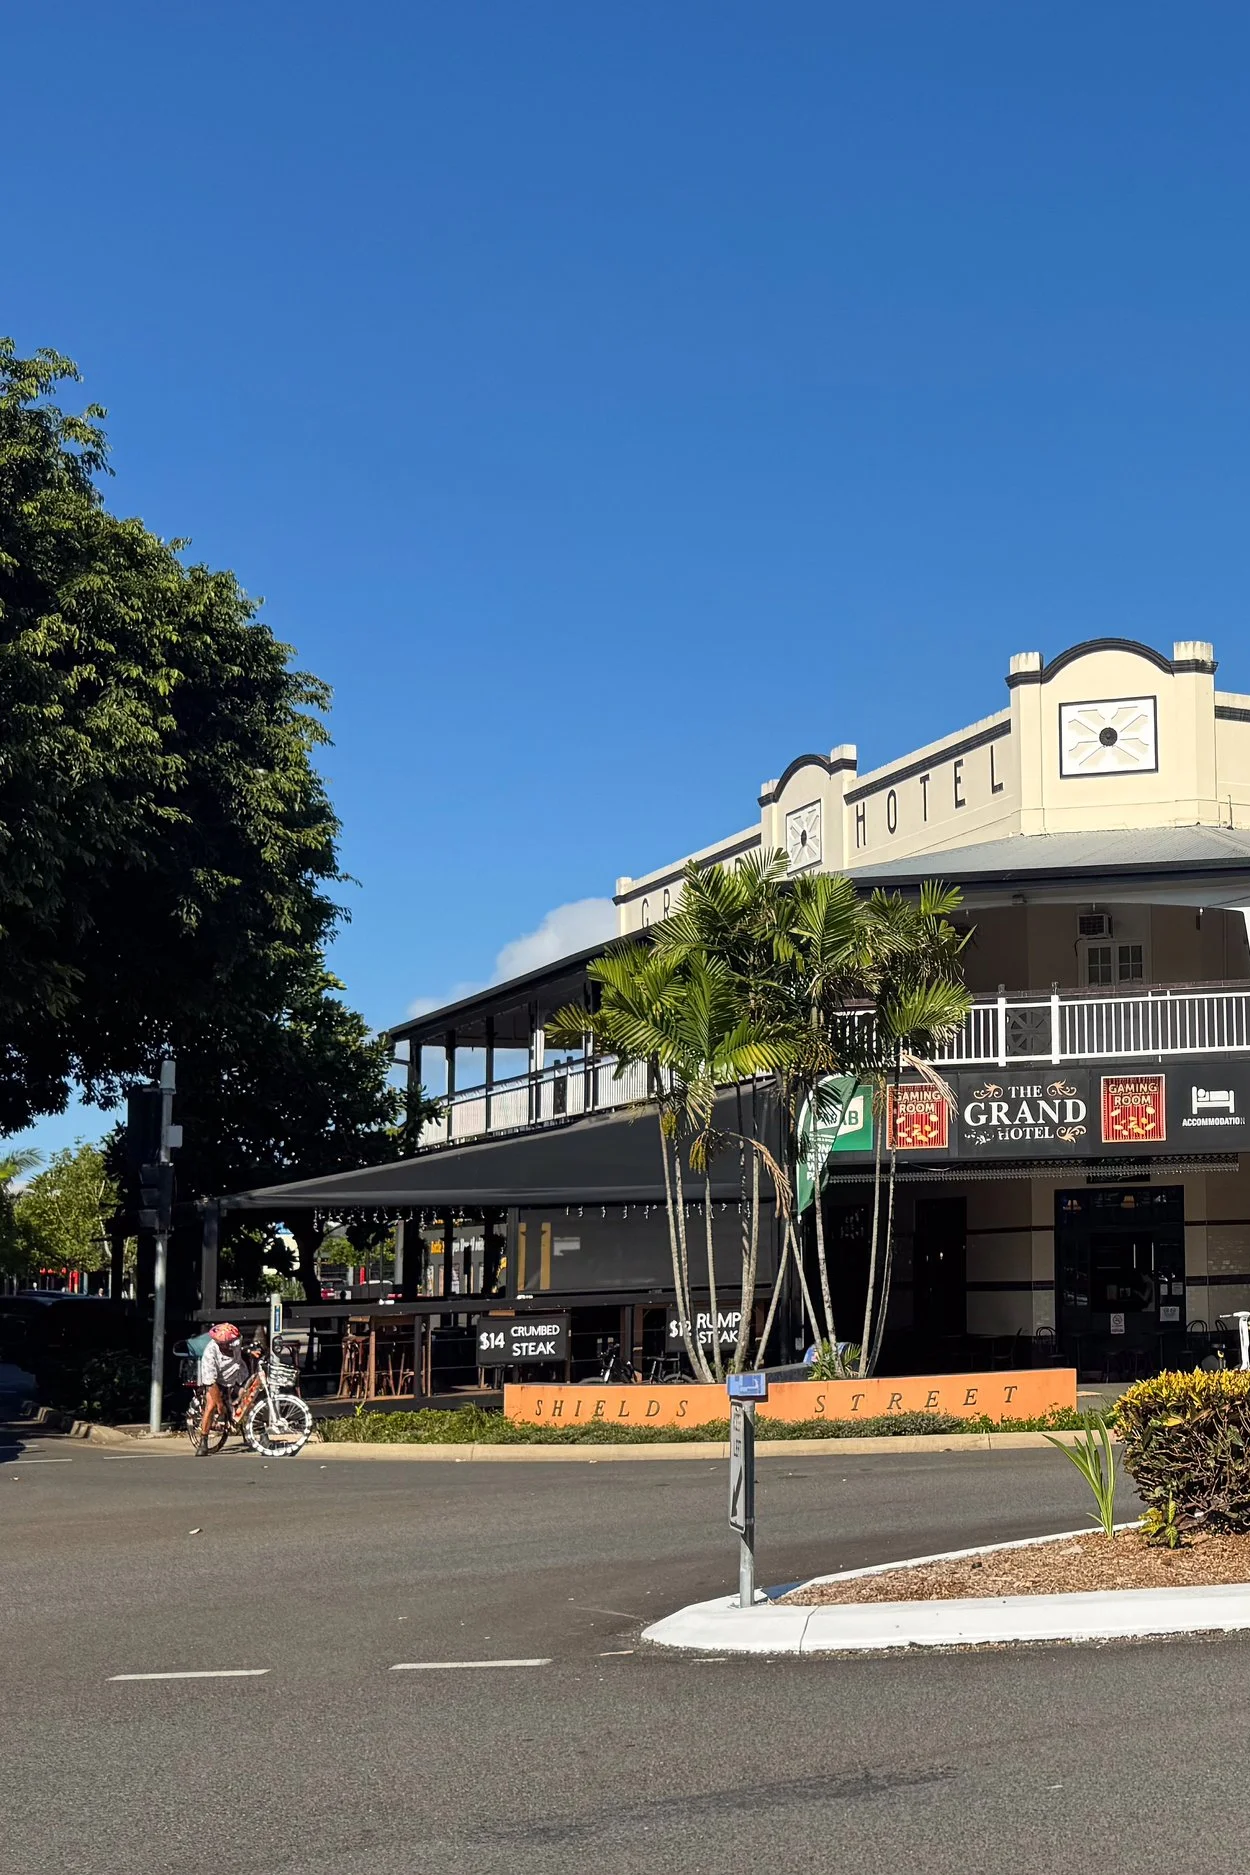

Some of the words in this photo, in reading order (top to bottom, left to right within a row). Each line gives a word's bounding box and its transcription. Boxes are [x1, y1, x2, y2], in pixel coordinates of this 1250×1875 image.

[856, 744, 1004, 849] HOTEL
[1008, 1085, 1043, 1099] THE
[1108, 1082, 1158, 1094] GAMING
[899, 1102, 936, 1114] ROOM
[1114, 1095, 1152, 1107] ROOM
[963, 1098, 1087, 1126] GRAND
[1182, 1116, 1246, 1127] ACCOMMODATION
[997, 1126, 1055, 1141] HOTEL
[696, 1312, 742, 1329] RUMP
[479, 1331, 505, 1351] $14
[510, 1324, 561, 1338] CRUMBED
[512, 1341, 556, 1357] STEAK
[535, 1399, 689, 1418] SHIELDS
[814, 1385, 1018, 1413] STREET
